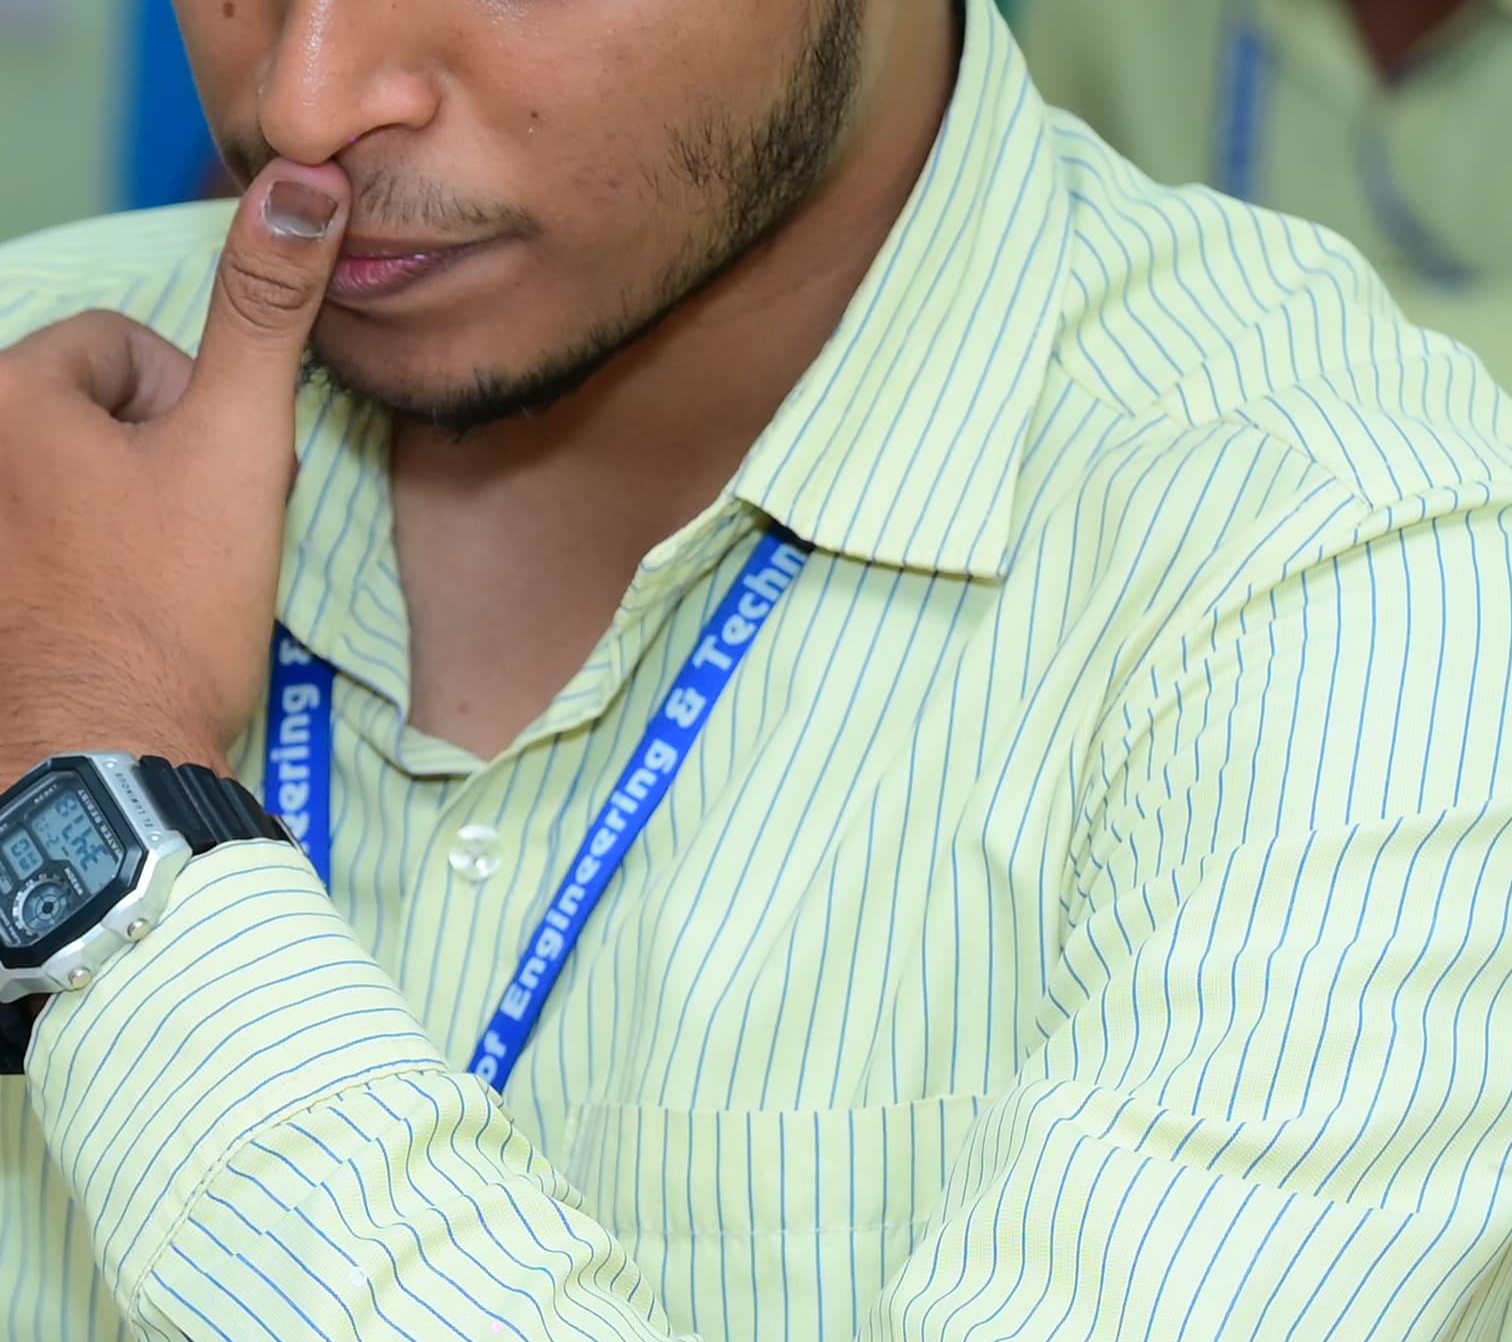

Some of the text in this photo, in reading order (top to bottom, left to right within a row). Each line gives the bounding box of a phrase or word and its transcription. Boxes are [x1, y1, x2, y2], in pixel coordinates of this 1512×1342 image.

[477, 1032, 507, 1087] of
[503, 738, 677, 1021] Engineering
[667, 687, 706, 728] &
